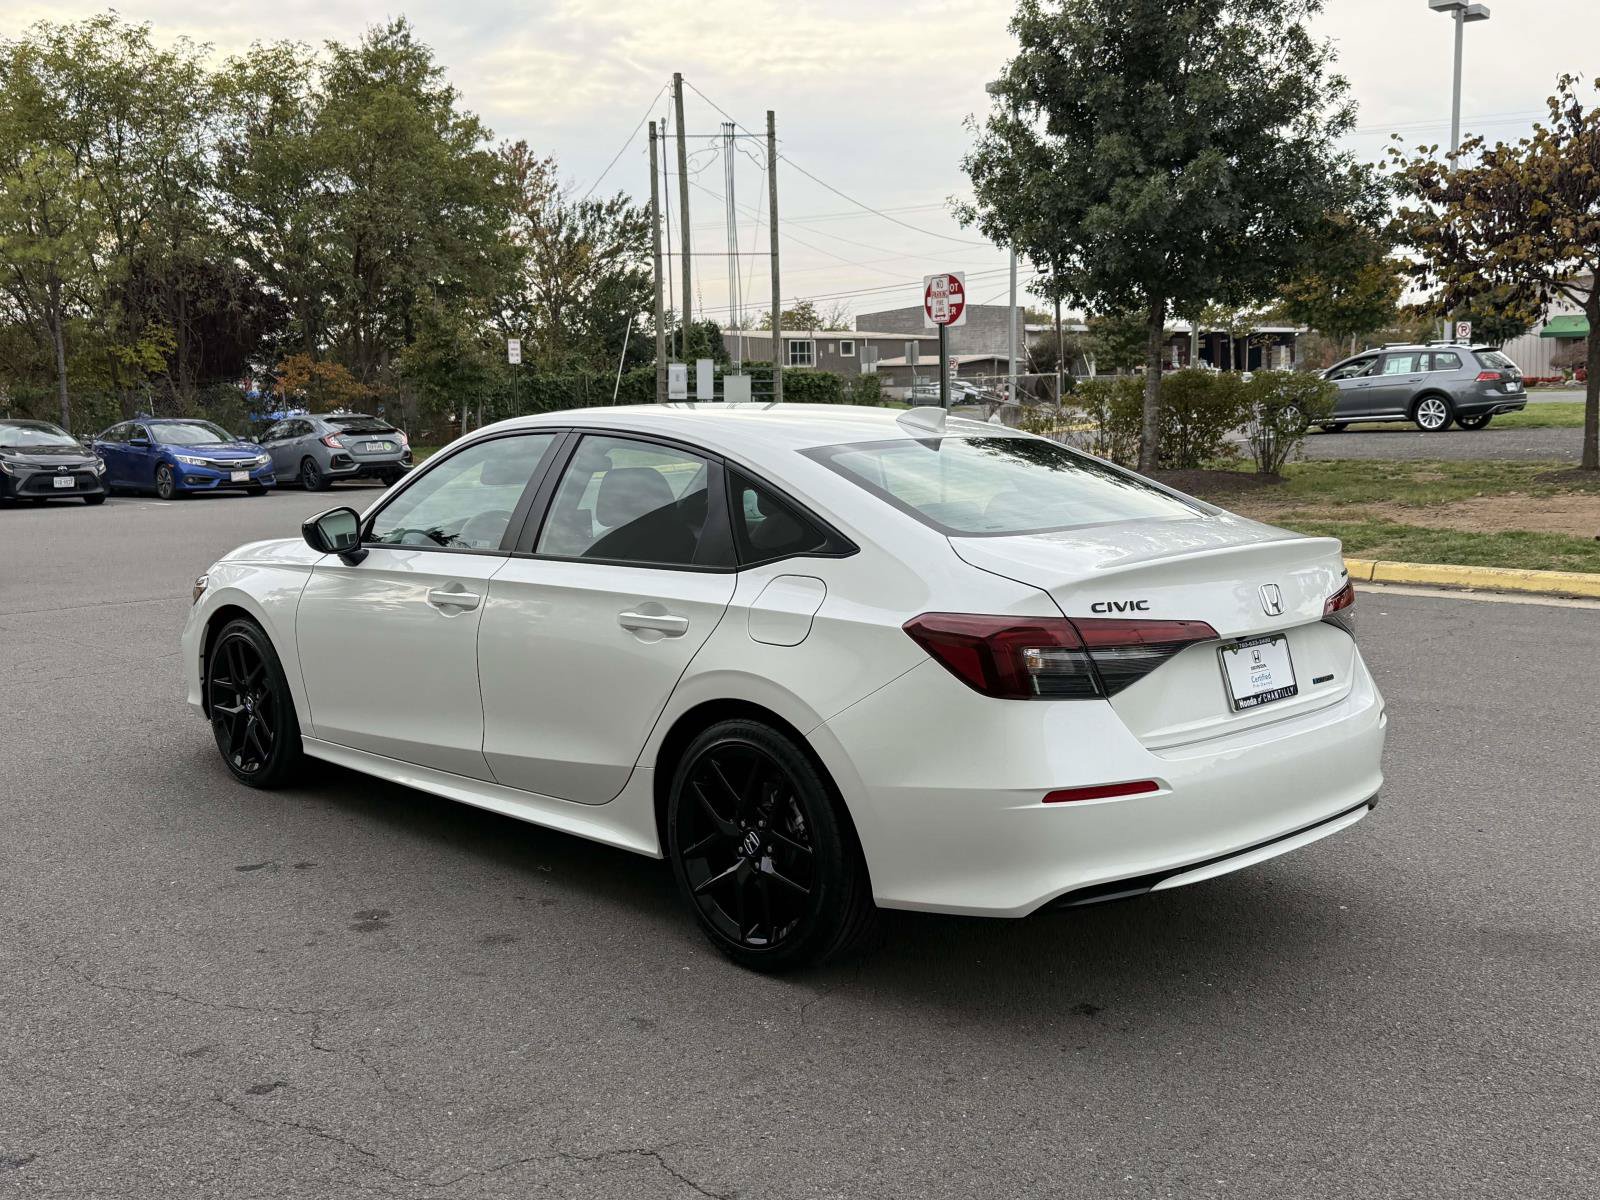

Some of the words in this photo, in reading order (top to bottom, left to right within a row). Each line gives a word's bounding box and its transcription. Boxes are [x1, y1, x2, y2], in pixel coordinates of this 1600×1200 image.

[1091, 600, 1150, 613] CIVIC
[1240, 697, 1257, 708] Honda
[1262, 686, 1294, 702] CHANTILLY
